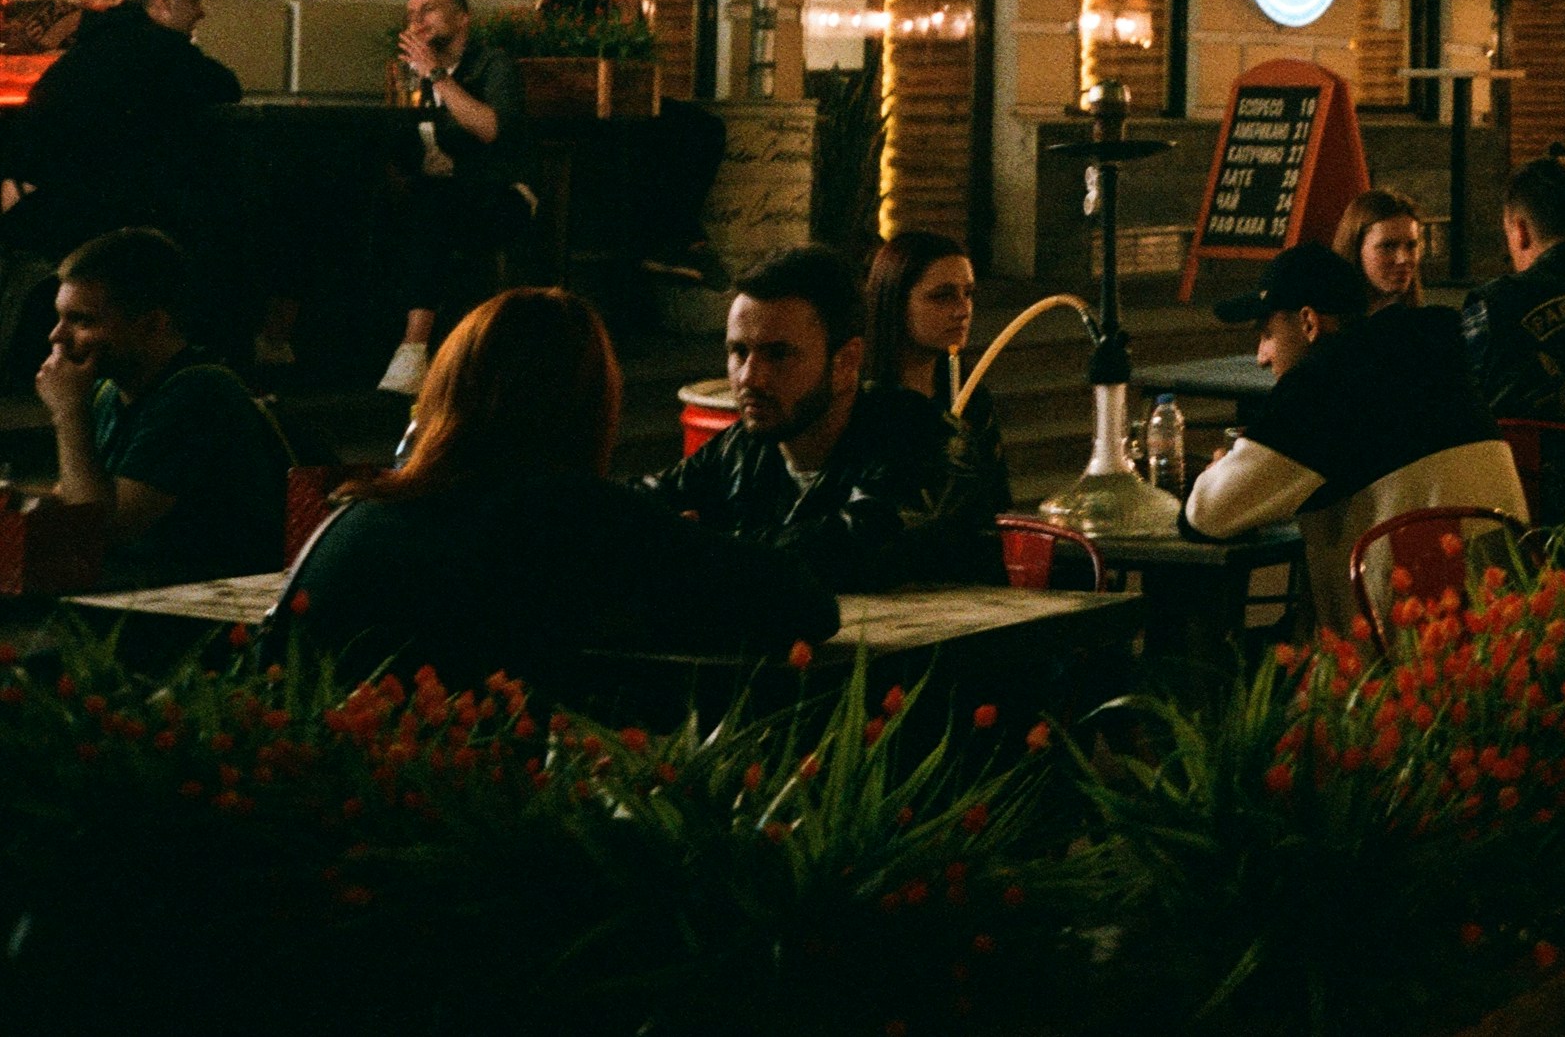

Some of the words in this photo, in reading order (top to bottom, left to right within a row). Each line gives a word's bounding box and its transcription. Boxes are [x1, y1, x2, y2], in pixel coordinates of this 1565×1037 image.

[1293, 122, 1309, 140] 21
[1221, 169, 1255, 187] ЛАТЕ
[1216, 188, 1241, 210] ЧАЙ
